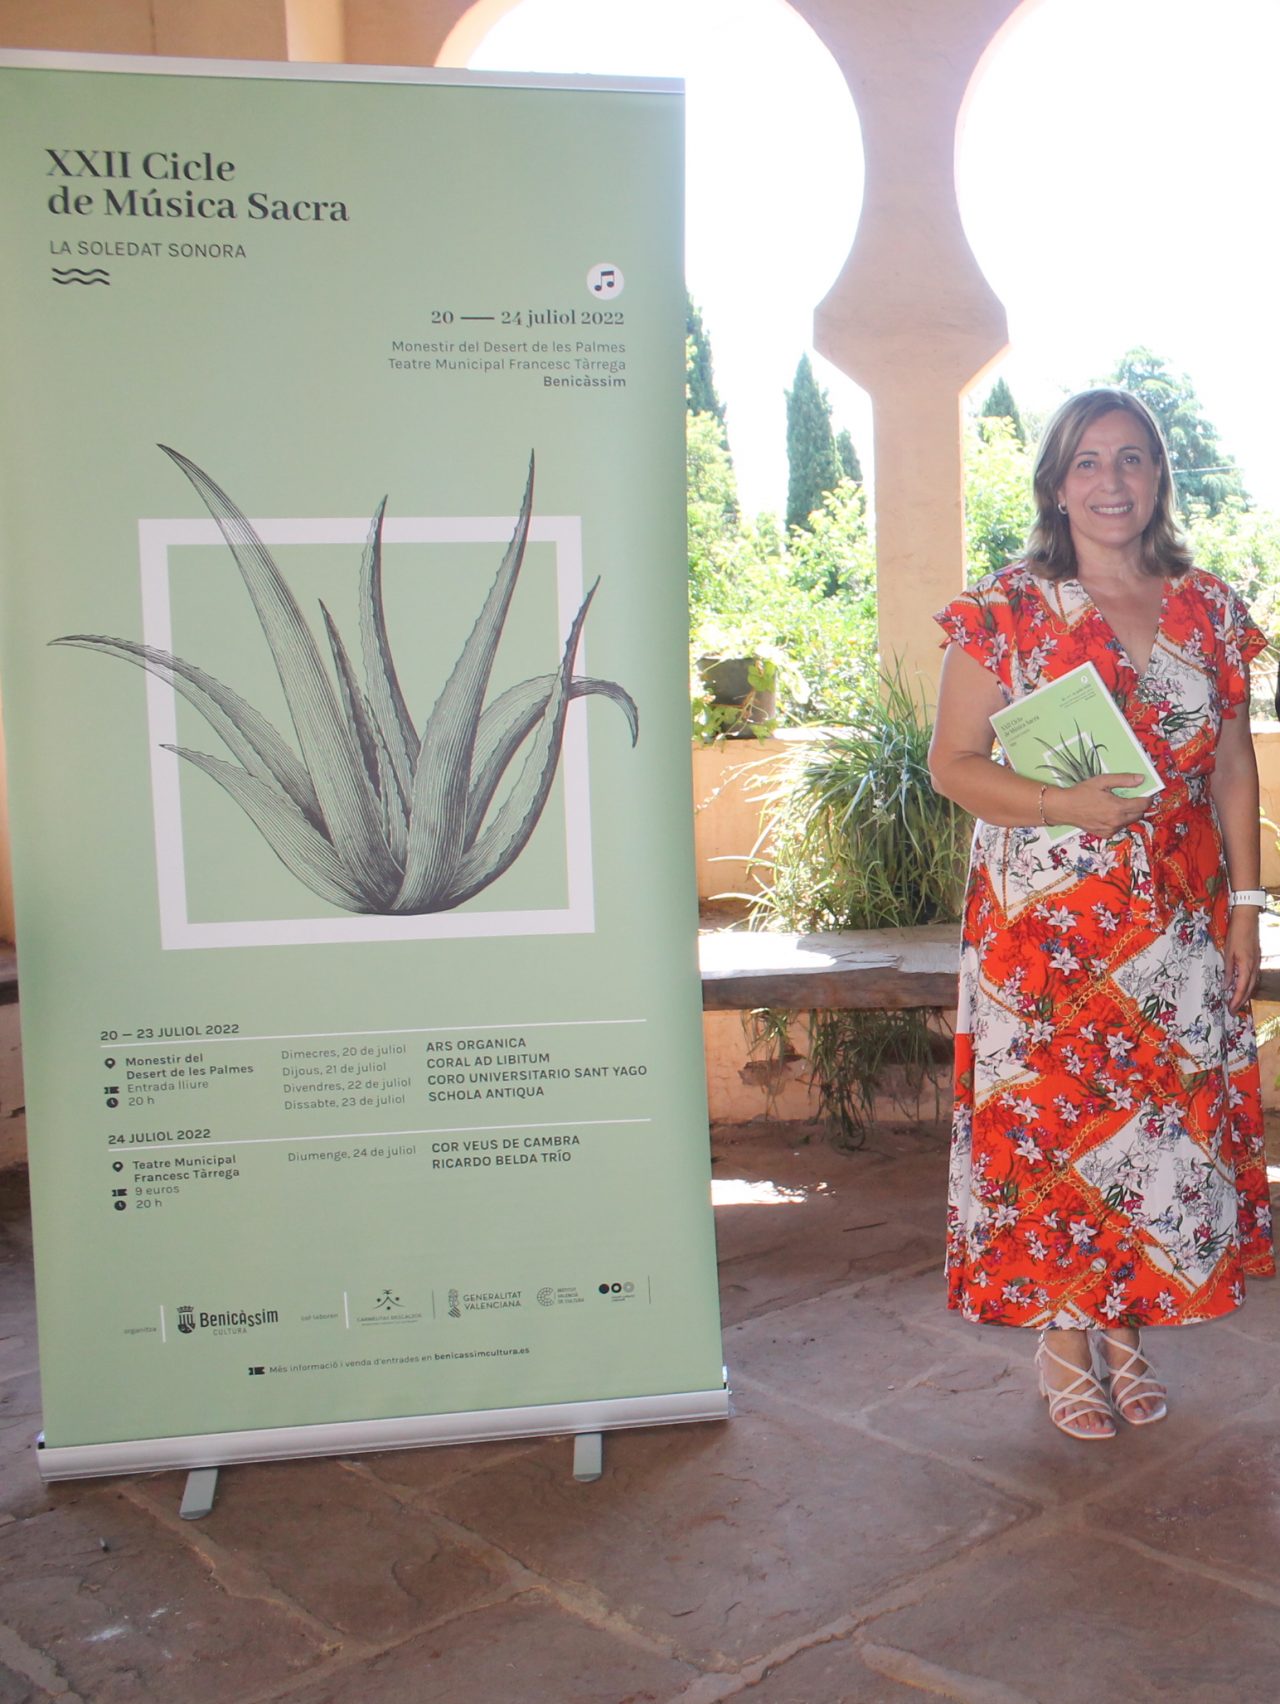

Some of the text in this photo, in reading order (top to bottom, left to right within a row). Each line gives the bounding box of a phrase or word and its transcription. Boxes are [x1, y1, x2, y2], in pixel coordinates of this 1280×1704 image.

[46, 149, 236, 181] XXII Cicle
[47, 186, 349, 221] de Música Sacra
[50, 240, 246, 258] LA SOLEDAT SONORA
[431, 310, 454, 324] 20
[501, 311, 521, 325] 24
[527, 309, 577, 328] juliol
[581, 312, 624, 325] 2022
[392, 341, 626, 353] Monestir del Desert de les Palmes
[389, 358, 626, 373] Teatre Municipal Francesc Tàrrega
[543, 376, 626, 388] Benicàssim
[100, 1030, 118, 1041] 20
[137, 1029, 154, 1039] 23
[158, 1026, 202, 1038] JULIOL
[205, 1024, 240, 1036] 2022
[281, 1044, 407, 1060] Dimecres, 20 de juliol
[426, 1037, 527, 1053] ARS ORGANICA
[126, 1053, 203, 1067] Monestir del
[427, 1053, 550, 1069] CORAL AD LIBITUM
[127, 1064, 254, 1080] Desert de les Palmes
[282, 1062, 387, 1079] Dijous, 21 de juliol
[427, 1064, 648, 1086] CORO UNIVERSITARIO SANT YAGO
[128, 1080, 209, 1094] Entrada lliure
[283, 1077, 412, 1094] Divendres, 22 de juliol
[128, 1095, 155, 1106] 20 h
[428, 1086, 545, 1102] SCHOLA ANTIQUA
[284, 1094, 406, 1111] Dissabte, 23 de juliol
[108, 1128, 212, 1145] 24 JULIOL 2022
[431, 1135, 581, 1153] COR VEUS DE CAMBRA
[287, 1145, 417, 1163] Diumenge, 24 de juliol
[432, 1149, 573, 1170] RICARDO BELDA TRÍO
[132, 1154, 237, 1171] Teatre Municipal
[134, 1168, 240, 1183] Francesc Tàrrega
[135, 1184, 180, 1196] 9 euros
[135, 1197, 162, 1209] 20 h
[463, 1291, 522, 1302] GENERALITAT
[464, 1300, 522, 1311] VALENCIANA
[212, 1327, 247, 1337] CULTURA
[269, 1365, 288, 1374] Més
[289, 1361, 338, 1373] informació
[345, 1359, 372, 1368] venda
[434, 1347, 530, 1361] benicassimcultura.es
